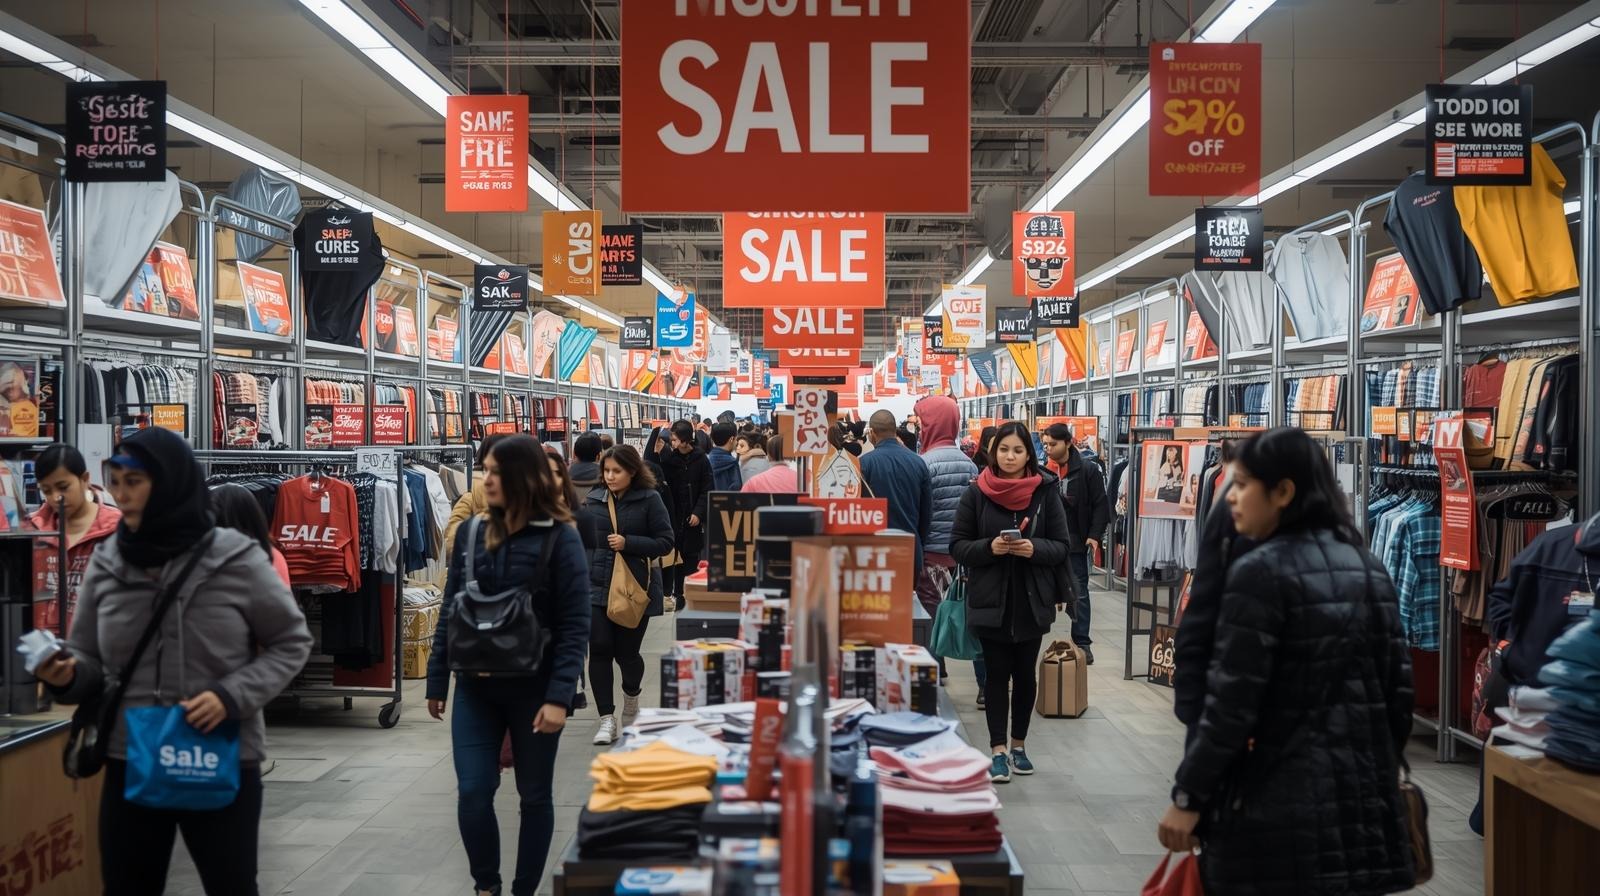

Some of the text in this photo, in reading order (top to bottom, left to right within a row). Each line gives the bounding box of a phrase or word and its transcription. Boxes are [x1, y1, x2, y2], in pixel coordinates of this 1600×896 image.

[657, 39, 930, 155] SALE
[1434, 98, 1488, 115] TODD
[1471, 122, 1523, 137] WORE
[315, 240, 360, 254] CURES
[739, 228, 868, 283] SALE
[481, 286, 511, 298] SAK
[772, 307, 855, 335] SALE
[277, 524, 340, 543] SALE
[160, 744, 219, 769] Sale
